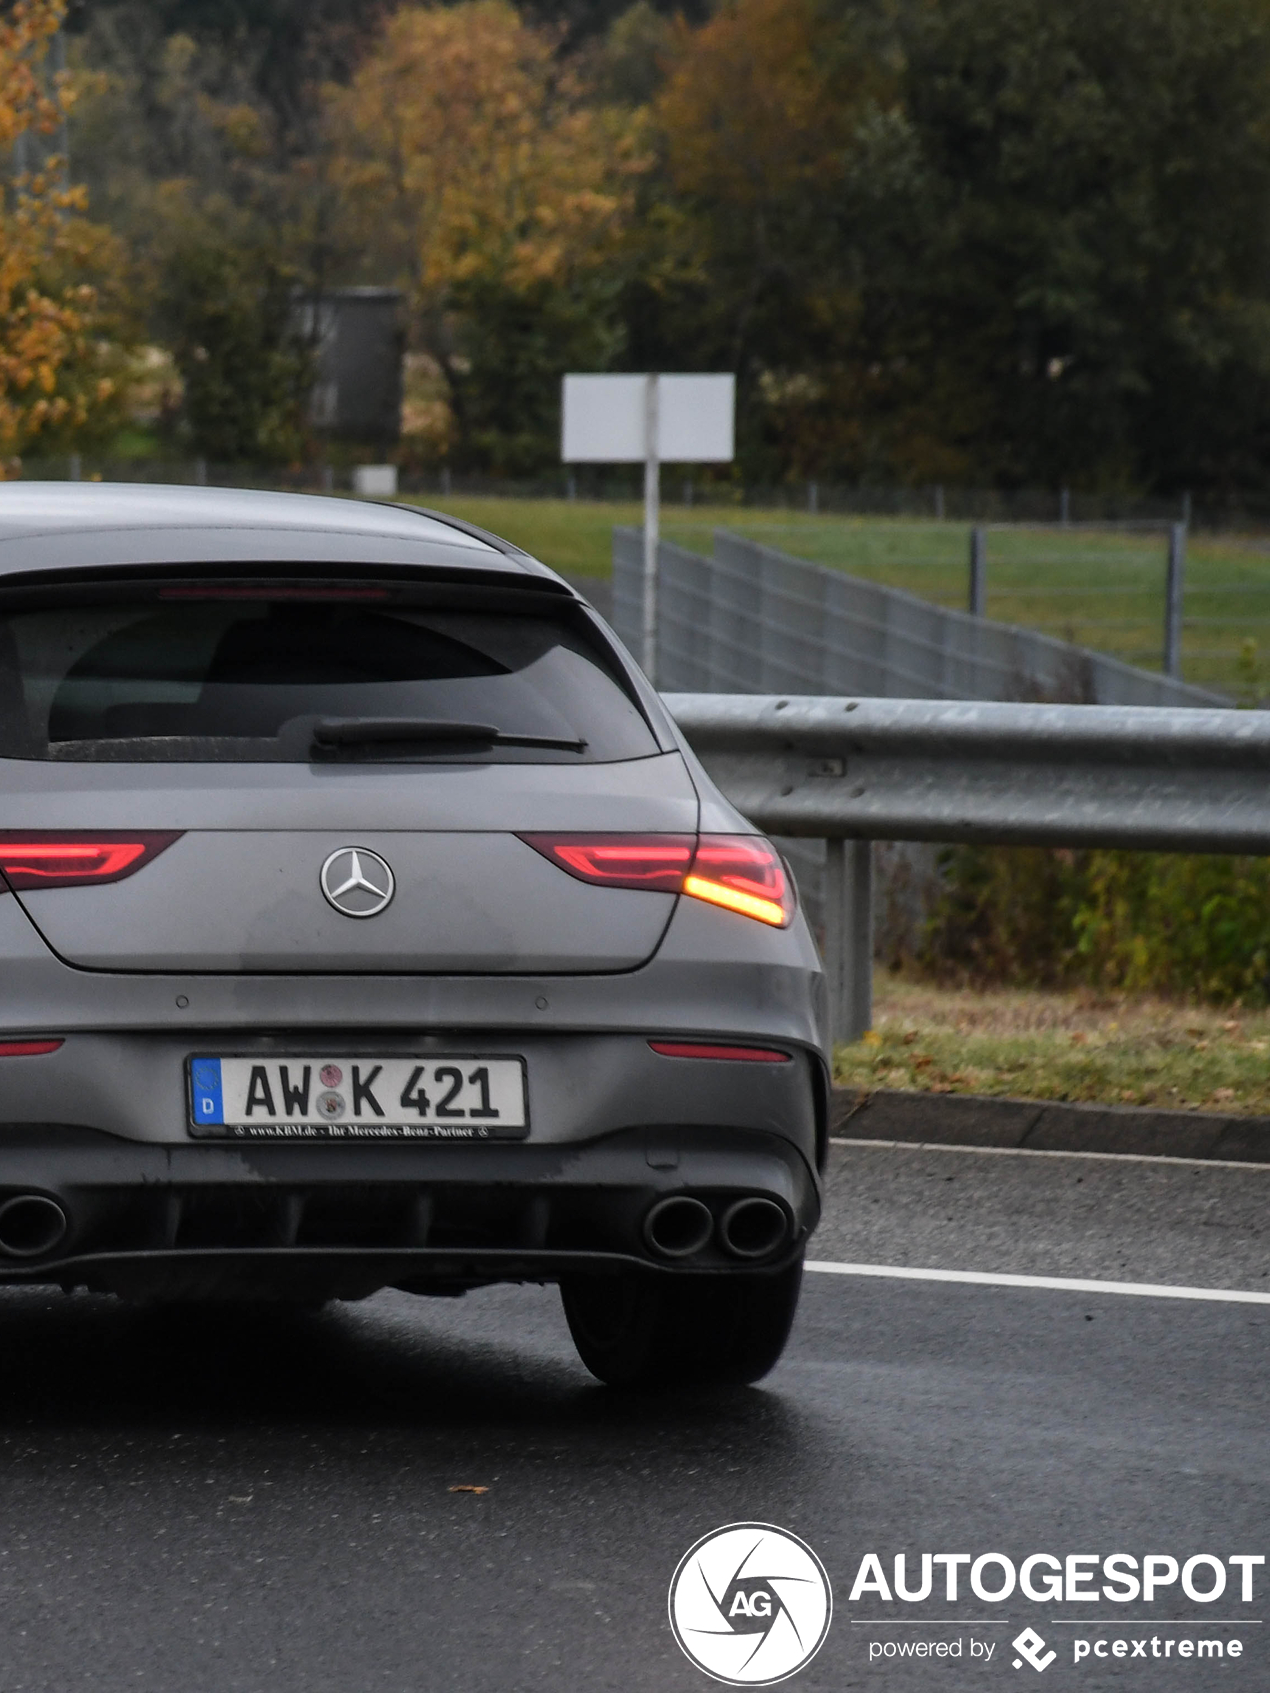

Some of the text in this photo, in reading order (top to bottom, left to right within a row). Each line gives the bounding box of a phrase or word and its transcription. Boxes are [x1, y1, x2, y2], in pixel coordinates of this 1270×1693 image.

[202, 1098, 215, 1115] D
[245, 1065, 500, 1118] AW K 421
